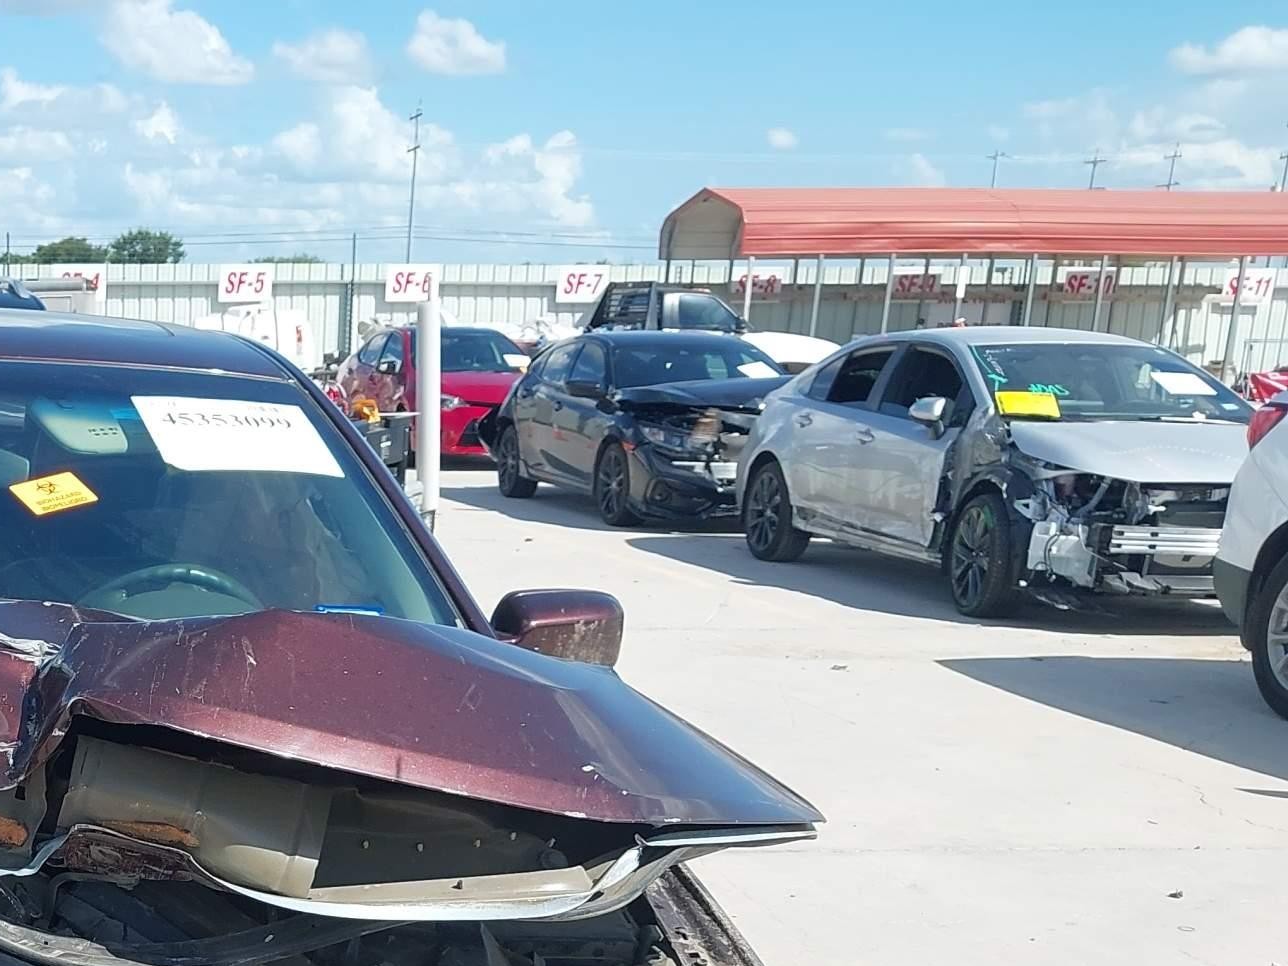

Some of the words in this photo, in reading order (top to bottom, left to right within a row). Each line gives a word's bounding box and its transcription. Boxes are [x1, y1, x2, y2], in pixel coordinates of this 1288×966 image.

[225, 272, 267, 294] SF-5
[564, 273, 603, 294] SF-7
[1065, 275, 1114, 294] SF-0
[161, 411, 292, 429] 45353099
